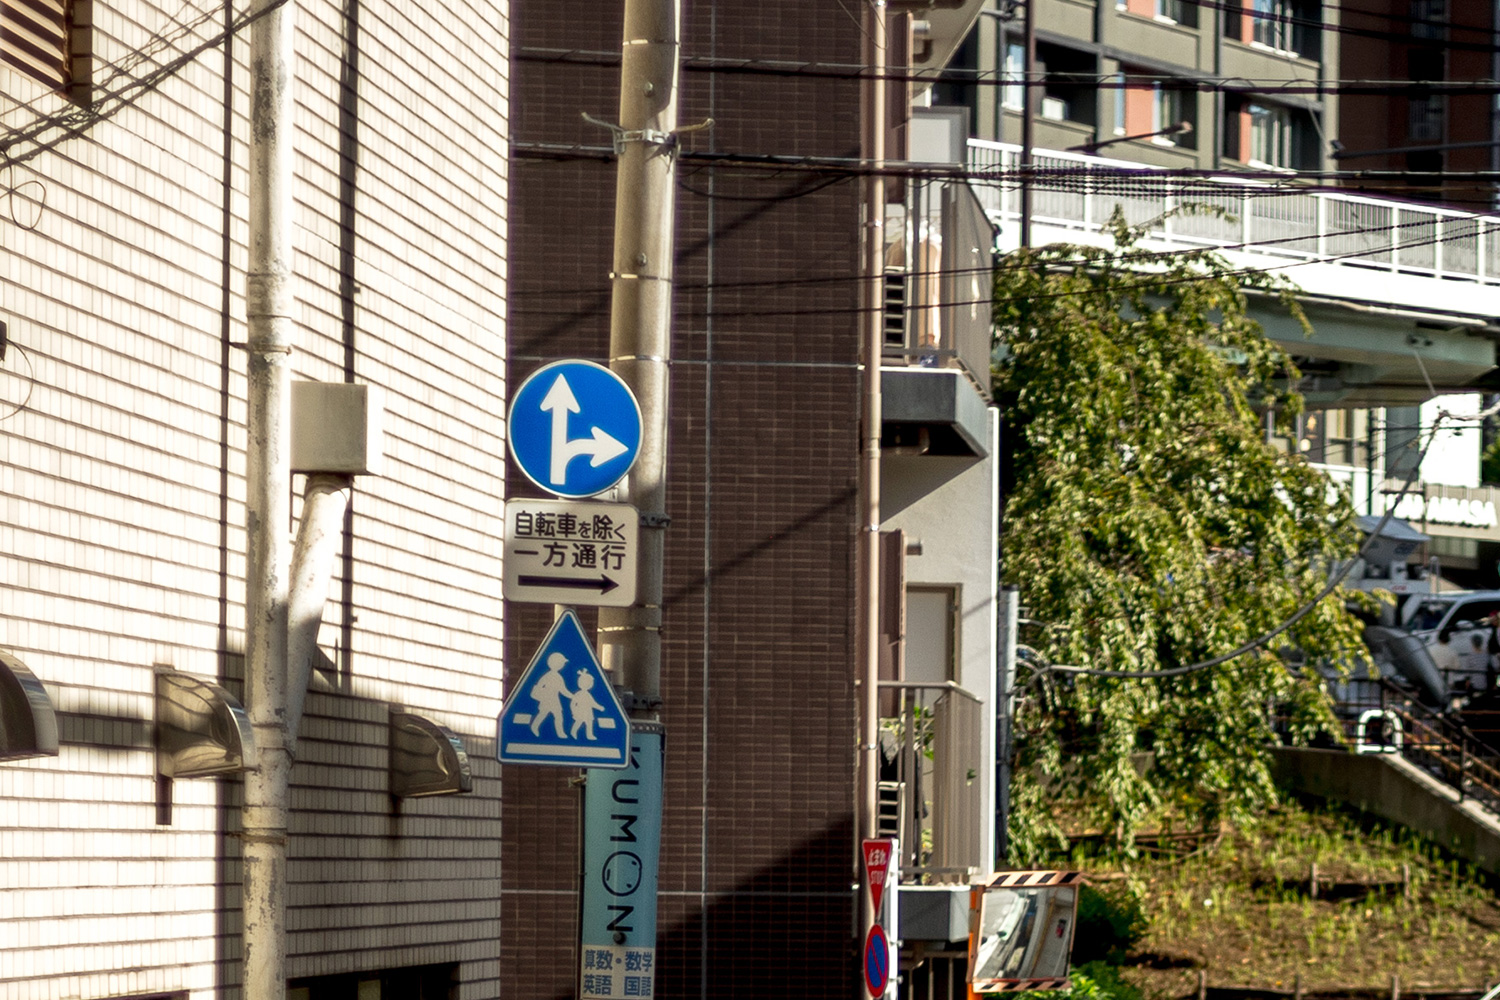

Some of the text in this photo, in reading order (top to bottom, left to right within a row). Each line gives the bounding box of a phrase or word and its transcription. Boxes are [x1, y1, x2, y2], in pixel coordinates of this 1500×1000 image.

[515, 510, 626, 541] 自転車を除く
[513, 541, 626, 570] 一方通行
[584, 949, 653, 972] 算数・数学
[583, 974, 651, 996] 英語 国語
